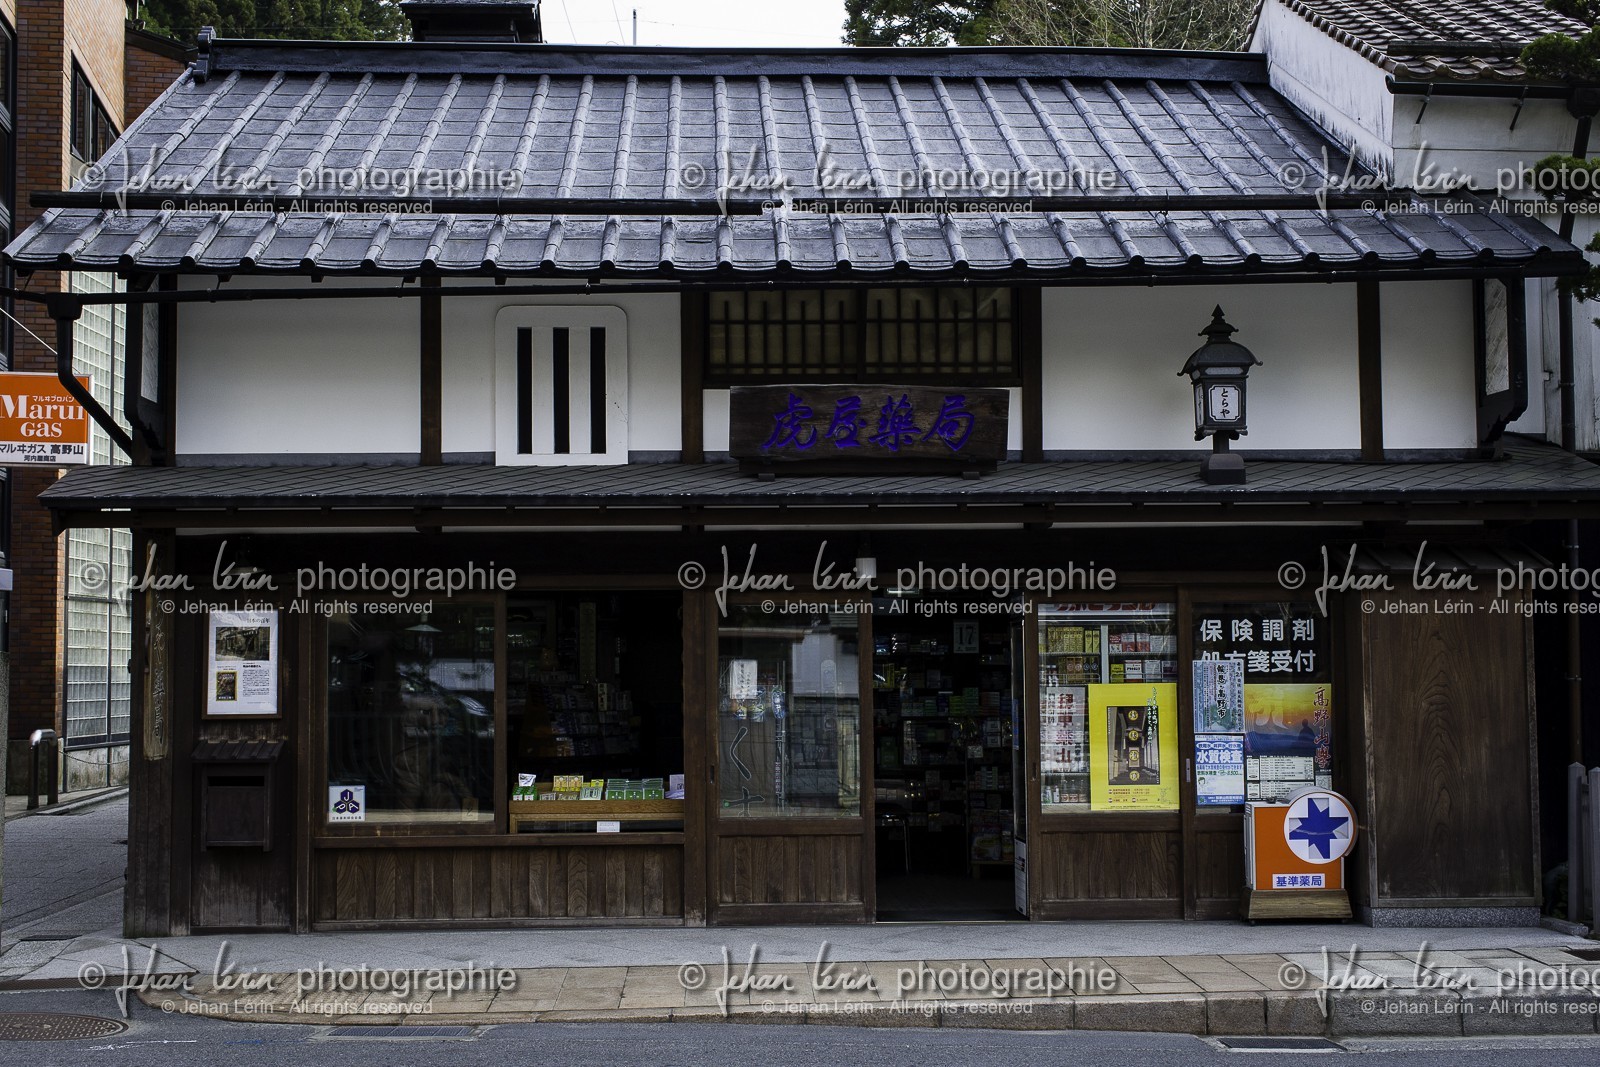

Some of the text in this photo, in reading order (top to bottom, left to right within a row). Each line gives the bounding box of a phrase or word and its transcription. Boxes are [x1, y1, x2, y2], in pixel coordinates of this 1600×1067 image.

[1220, 388, 1230, 418] とらや
[50, 444, 84, 455] 高野山
[1200, 618, 1315, 641] 保険調剤
[1197, 750, 1243, 764] 水質検査
[1276, 875, 1322, 887] 基準薬局
